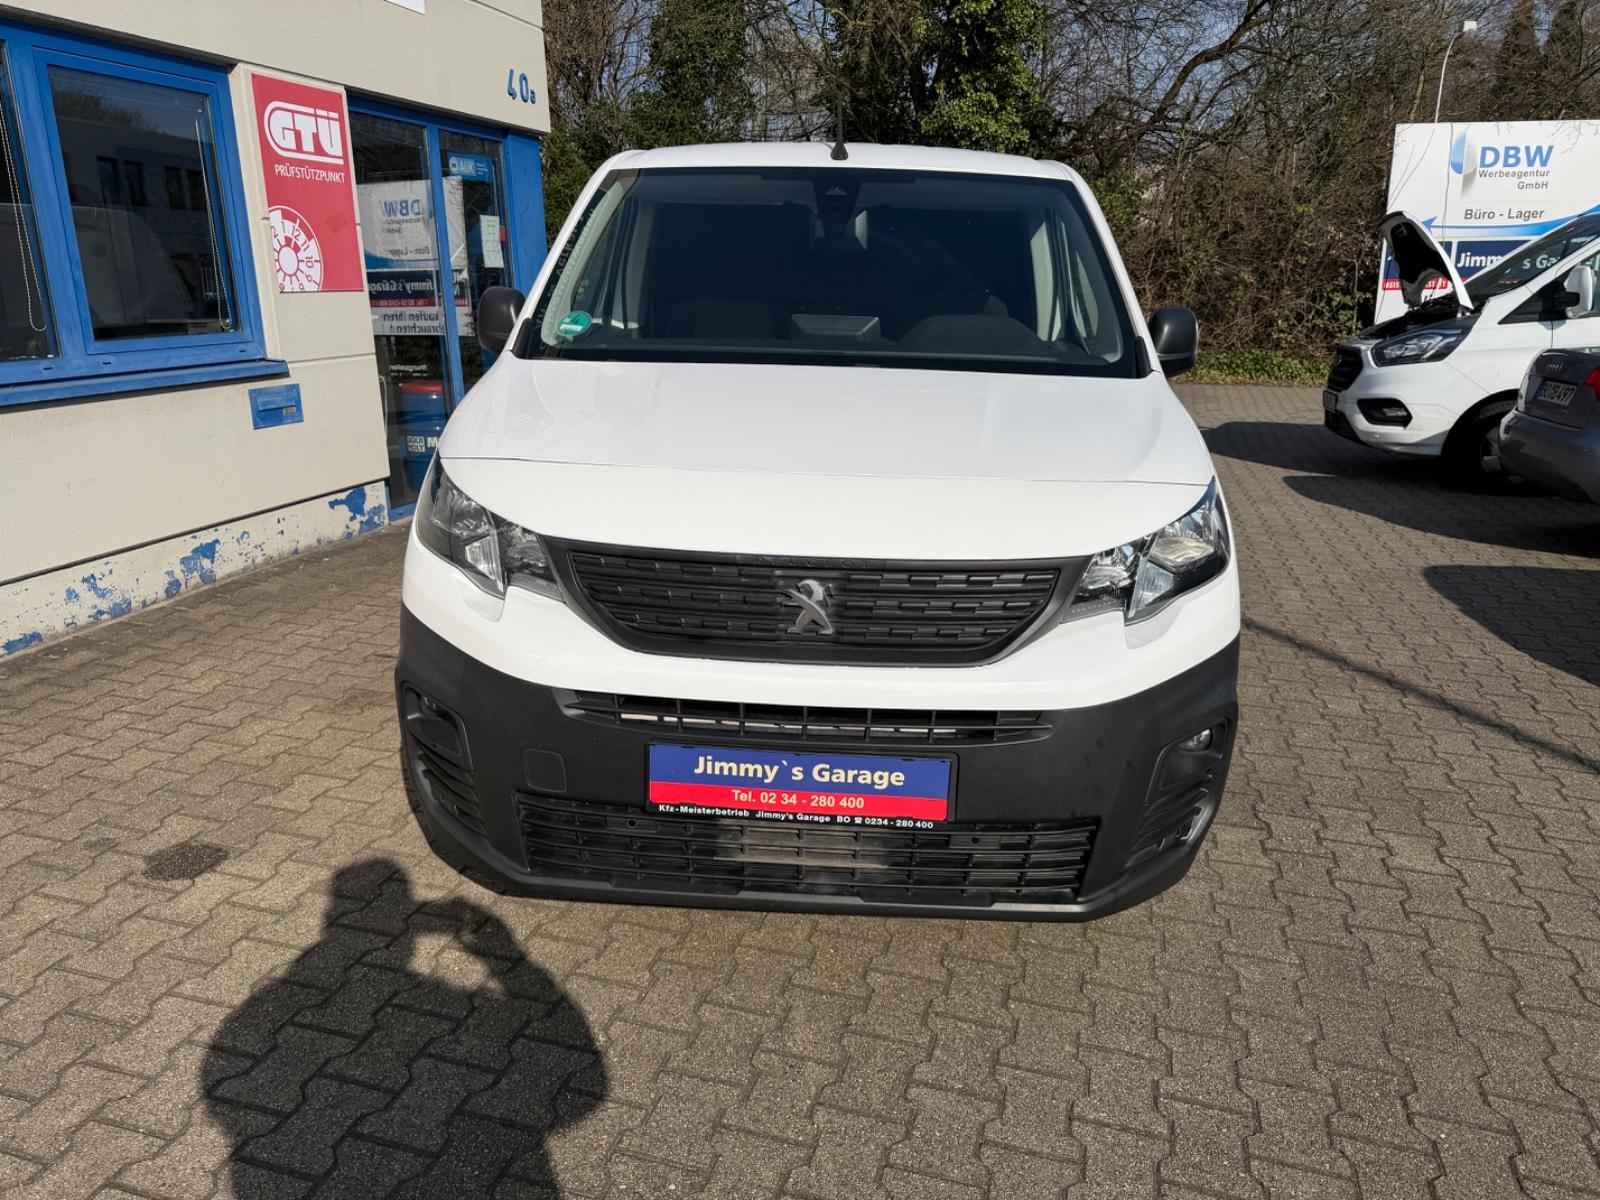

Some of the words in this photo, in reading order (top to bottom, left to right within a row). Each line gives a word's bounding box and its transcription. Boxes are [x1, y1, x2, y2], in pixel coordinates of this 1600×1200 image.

[268, 107, 343, 158] GTÜ
[1479, 145, 1554, 168] DBW
[274, 163, 345, 183] PRÜFSTÜTZPUNKT
[1478, 169, 1550, 179] Werbeagentur
[1517, 181, 1548, 190] GmbH
[1464, 208, 1496, 220] Büro
[1507, 208, 1545, 221] Lager
[812, 763, 905, 790] Garage
[732, 789, 755, 802] Tel.
[760, 791, 776, 803] 02
[781, 793, 797, 805] 34
[810, 795, 835, 807] 280
[839, 797, 864, 809] 400
[755, 810, 793, 821] Jimmy's
[796, 813, 830, 823] Garage
[837, 815, 850, 823] BO
[865, 817, 889, 826] 0234
[896, 820, 913, 828] 280
[915, 820, 934, 829] 400
